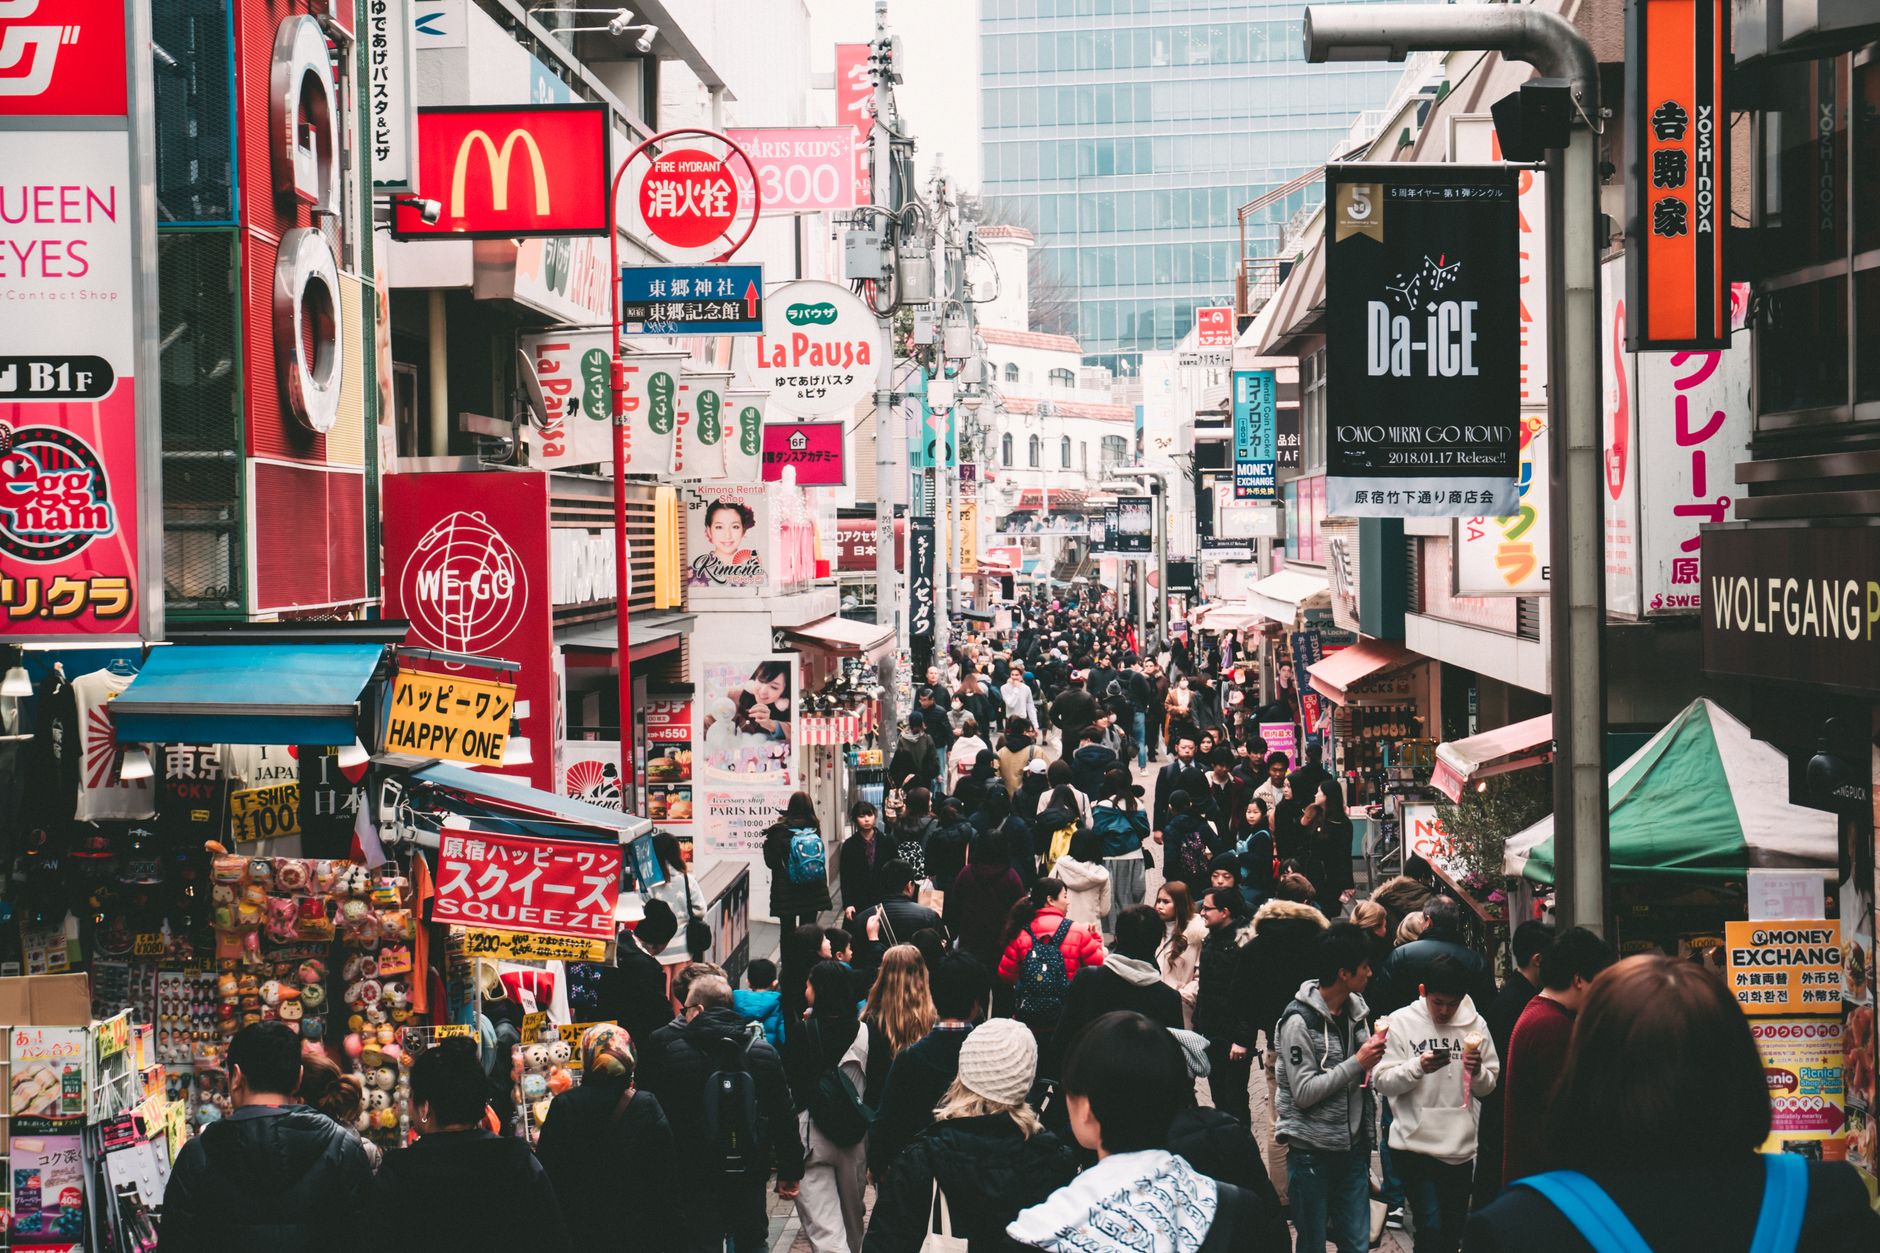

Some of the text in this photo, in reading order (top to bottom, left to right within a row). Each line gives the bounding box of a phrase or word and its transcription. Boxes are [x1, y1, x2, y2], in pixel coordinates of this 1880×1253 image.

[794, 140, 841, 158] KID'S
[655, 160, 721, 173] FIRE HYDRANT
[1651, 100, 1689, 238] 吉野家
[647, 178, 731, 218] 消火栓
[0, 239, 89, 278] YES
[648, 278, 735, 298] 東郷神社
[648, 302, 740, 321] 東郷記念館
[1368, 301, 1480, 378] Da-iCE
[757, 332, 871, 370] La Pausa
[28, 362, 93, 393] B1F
[1249, 377, 1262, 458] コインロッカー
[791, 438, 804, 447] 6F
[1336, 425, 1386, 443] TOKYO
[1425, 425, 1461, 443] GO
[1388, 451, 1452, 464] 2018.01.17
[1456, 451, 1506, 464] Release!!
[1236, 464, 1274, 476] MONEY
[698, 485, 766, 494] Kimono Rental
[1236, 477, 1275, 487] EXCHANGE
[688, 502, 703, 510] 3F
[719, 494, 744, 504] Shop
[1354, 489, 1494, 505] 原宿竹下通り商店会
[1711, 575, 1860, 641] WOLFGANG
[396, 684, 510, 722] ハッピーワン
[388, 719, 504, 761] HAPPY ONE
[659, 728, 688, 739] ¥550
[710, 806, 746, 816] PARIS
[442, 836, 619, 873] 原宿ハッピーワン
[439, 861, 617, 913] スクイーズ
[436, 898, 613, 931] SQUEEZE
[1769, 930, 1834, 945] MONEY
[1735, 972, 1788, 986] 外貨両替
[1289, 1045, 1304, 1066] 3
